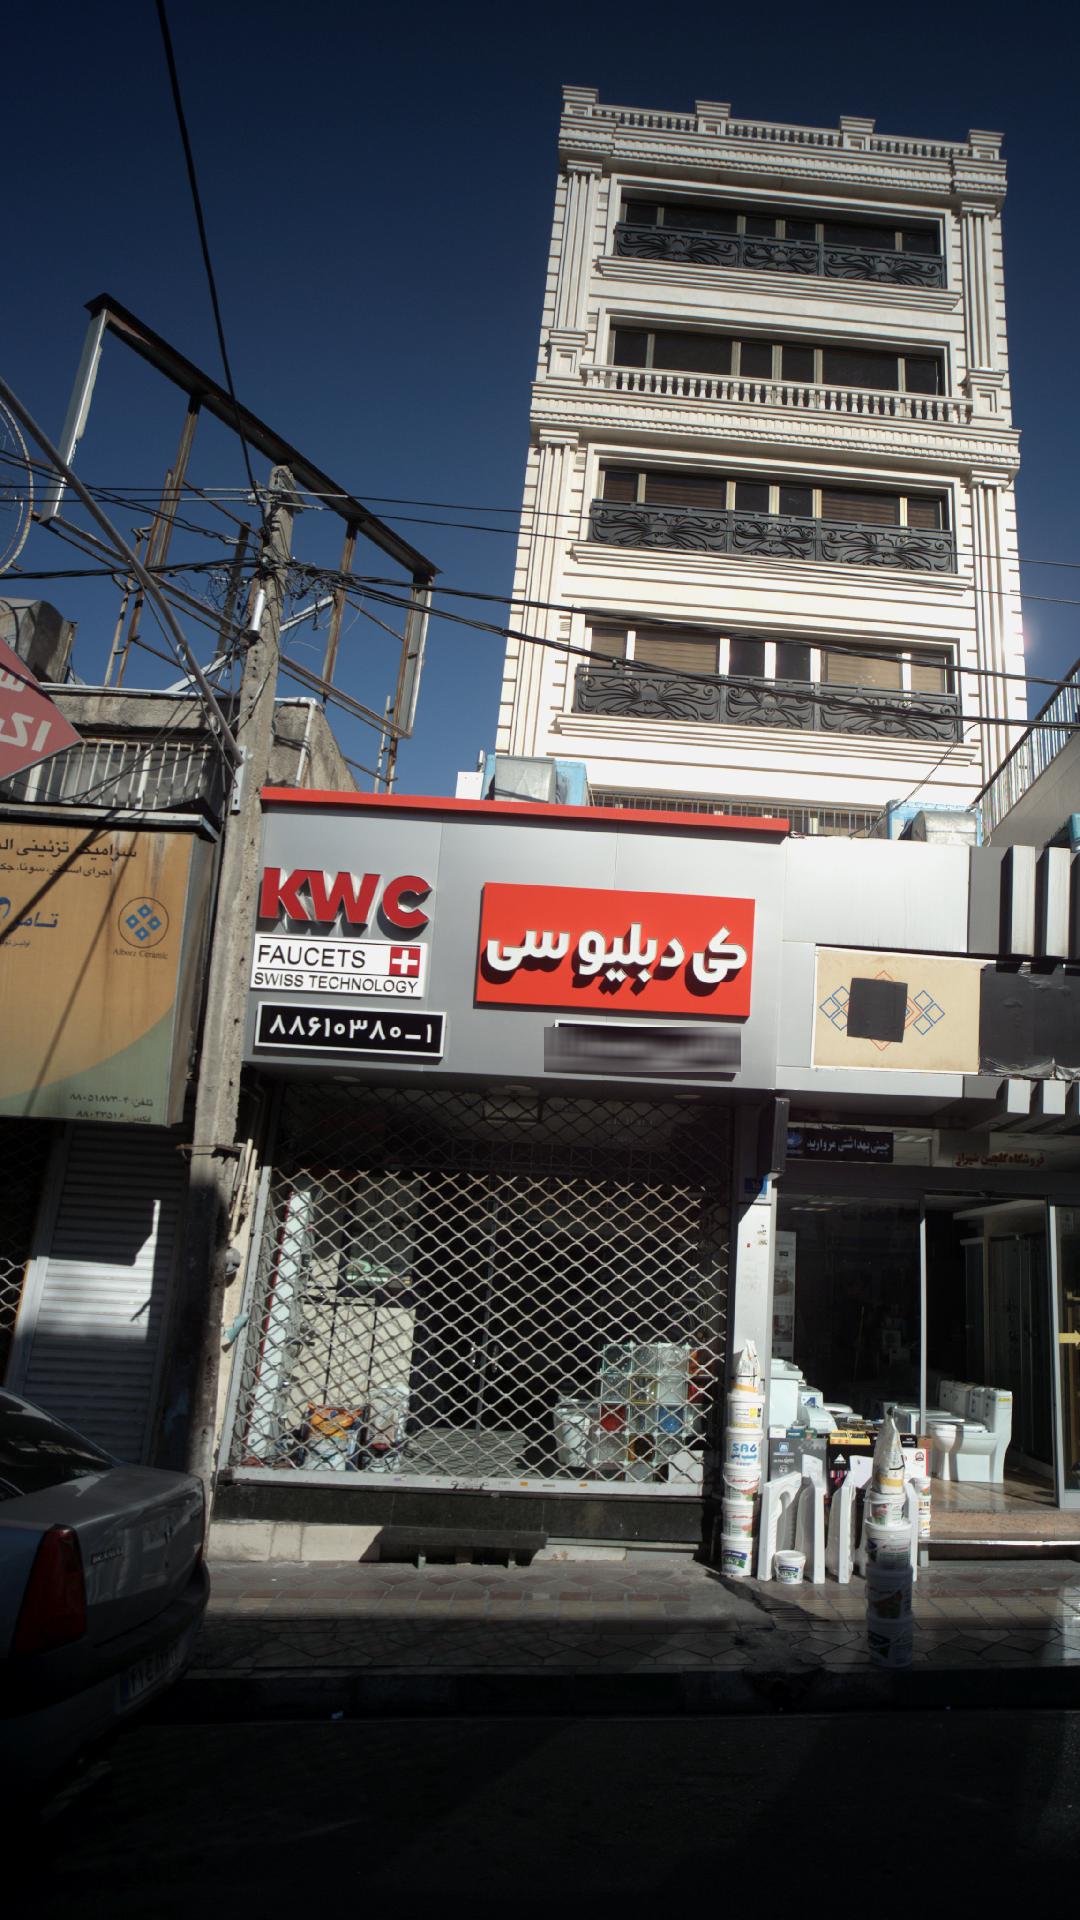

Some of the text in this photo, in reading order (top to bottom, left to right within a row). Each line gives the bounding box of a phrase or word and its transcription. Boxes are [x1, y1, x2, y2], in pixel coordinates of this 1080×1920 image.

[259, 866, 433, 928] KWC
[257, 944, 366, 969] FAUCETS
[487, 922, 748, 983] کی دبلیو سی
[254, 972, 418, 994] SWISS TECHNOLOGY
